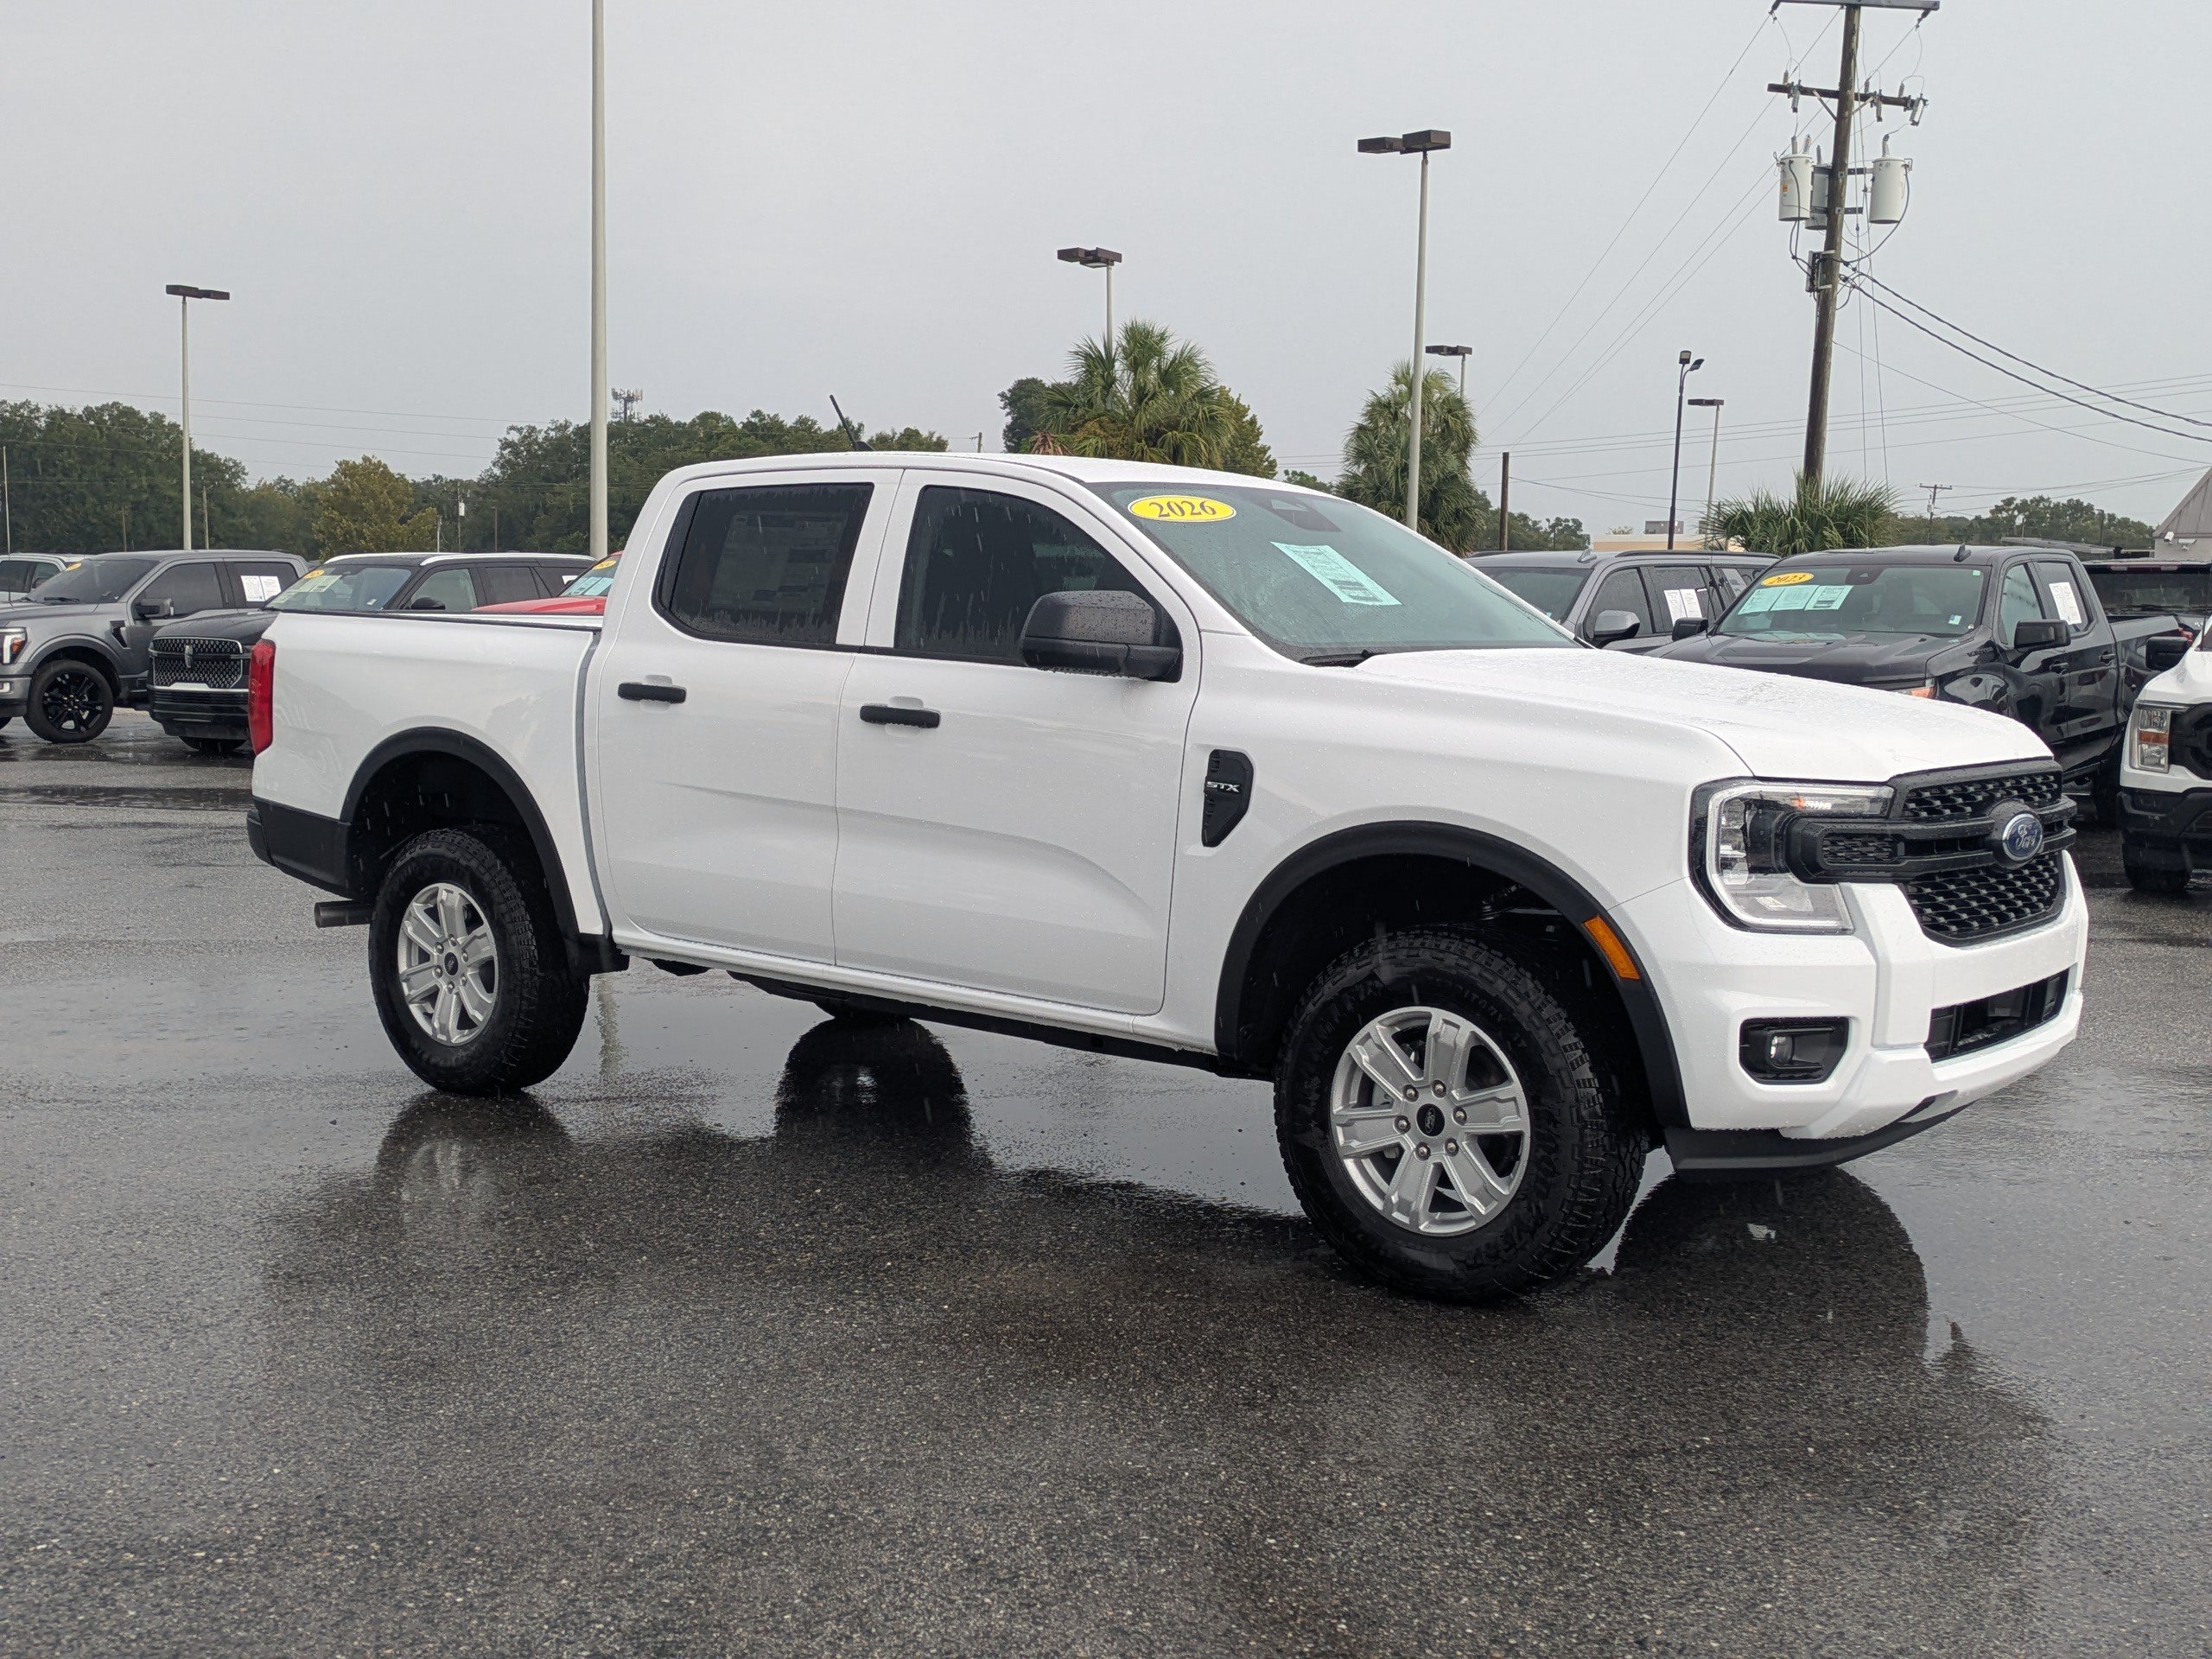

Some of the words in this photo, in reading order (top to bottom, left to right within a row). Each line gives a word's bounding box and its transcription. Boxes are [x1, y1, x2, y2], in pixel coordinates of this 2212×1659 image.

[1148, 500, 1217, 518] 2026
[1206, 781, 1240, 793] STX
[2015, 823, 2038, 850] Ford
